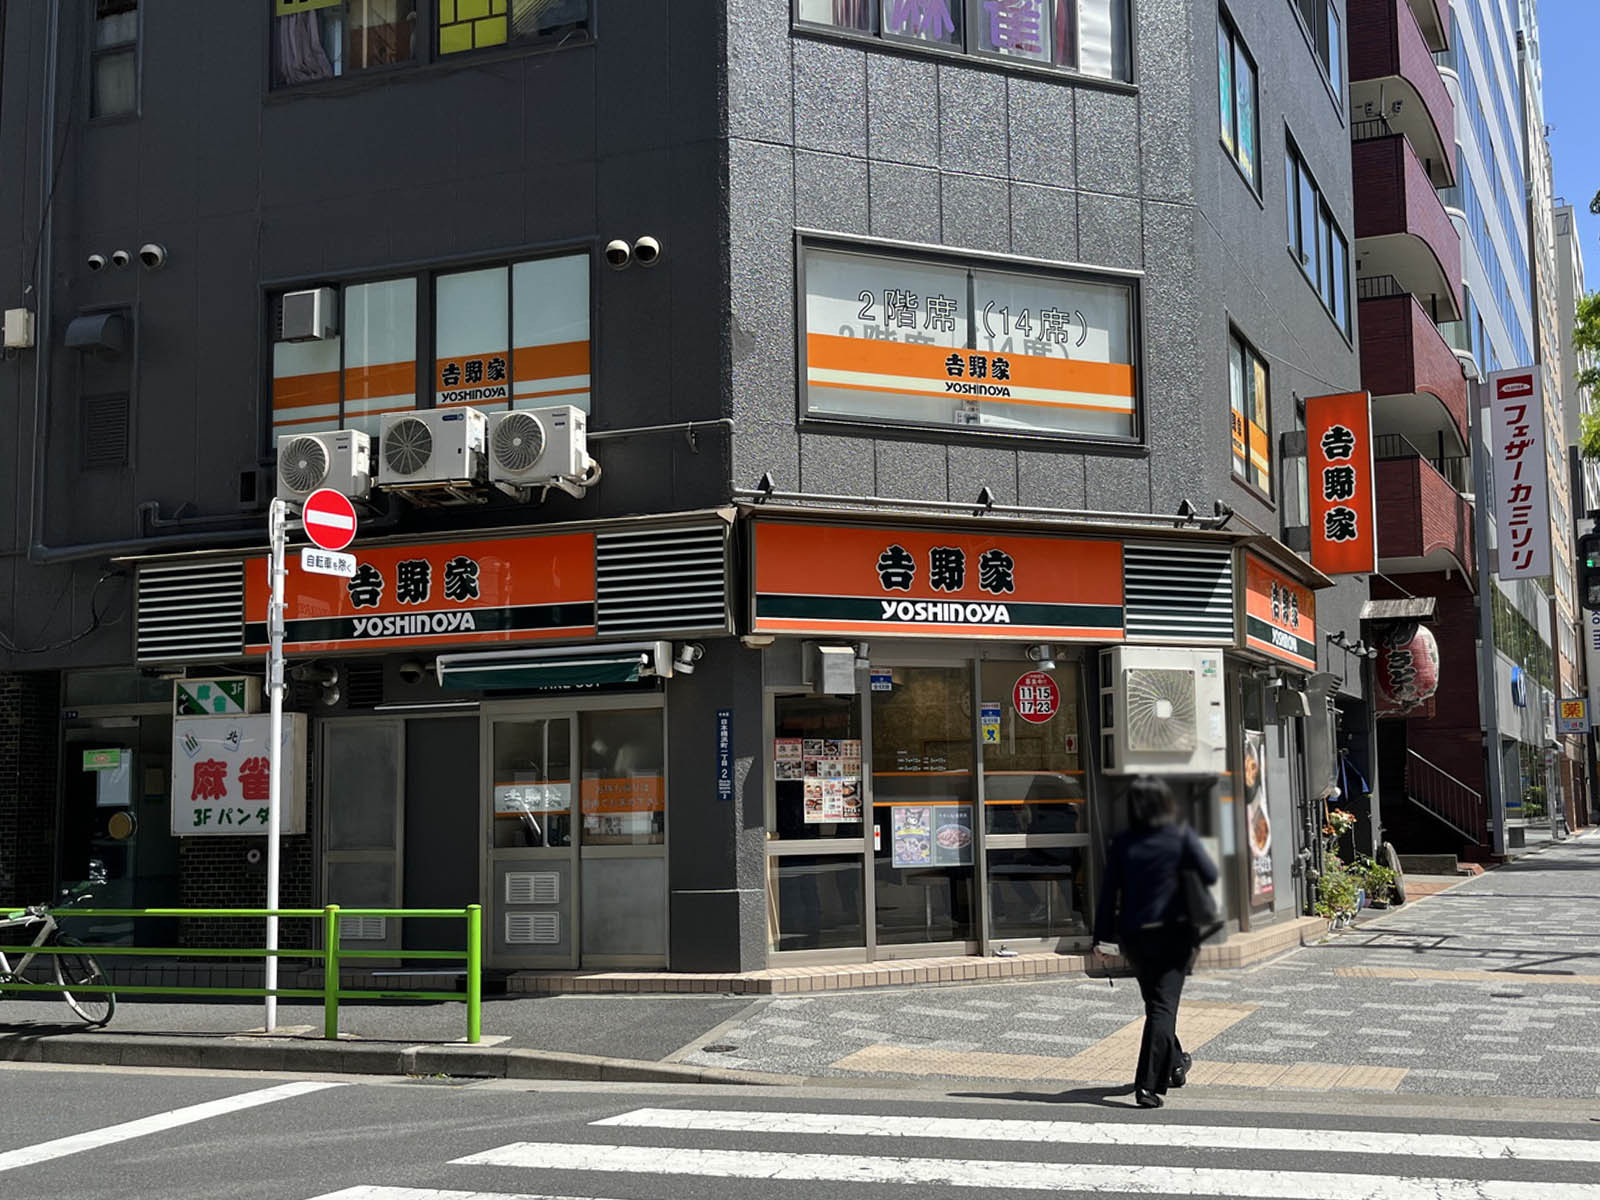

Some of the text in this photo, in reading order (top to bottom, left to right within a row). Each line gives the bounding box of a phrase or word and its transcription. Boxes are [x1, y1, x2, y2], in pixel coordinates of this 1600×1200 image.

[858, 290, 958, 333] 2階席
[442, 357, 506, 387] 吉野家
[945, 353, 1010, 381] 吉野家
[442, 386, 506, 403] YOSHINOYA
[945, 381, 1011, 398] YOSHINOYA
[1320, 424, 1358, 542] 吉野家
[1504, 404, 1535, 570] フェザーカミソリ
[306, 554, 352, 574] 自転車を除く
[875, 544, 1016, 595] 吉野家
[348, 555, 481, 609] 吉野家
[352, 611, 476, 637] YOSHINOYA
[881, 601, 1011, 624] YOSHINOYA
[231, 683, 243, 695] 3F
[1563, 702, 1581, 717] 薬
[721, 768, 728, 778] 2
